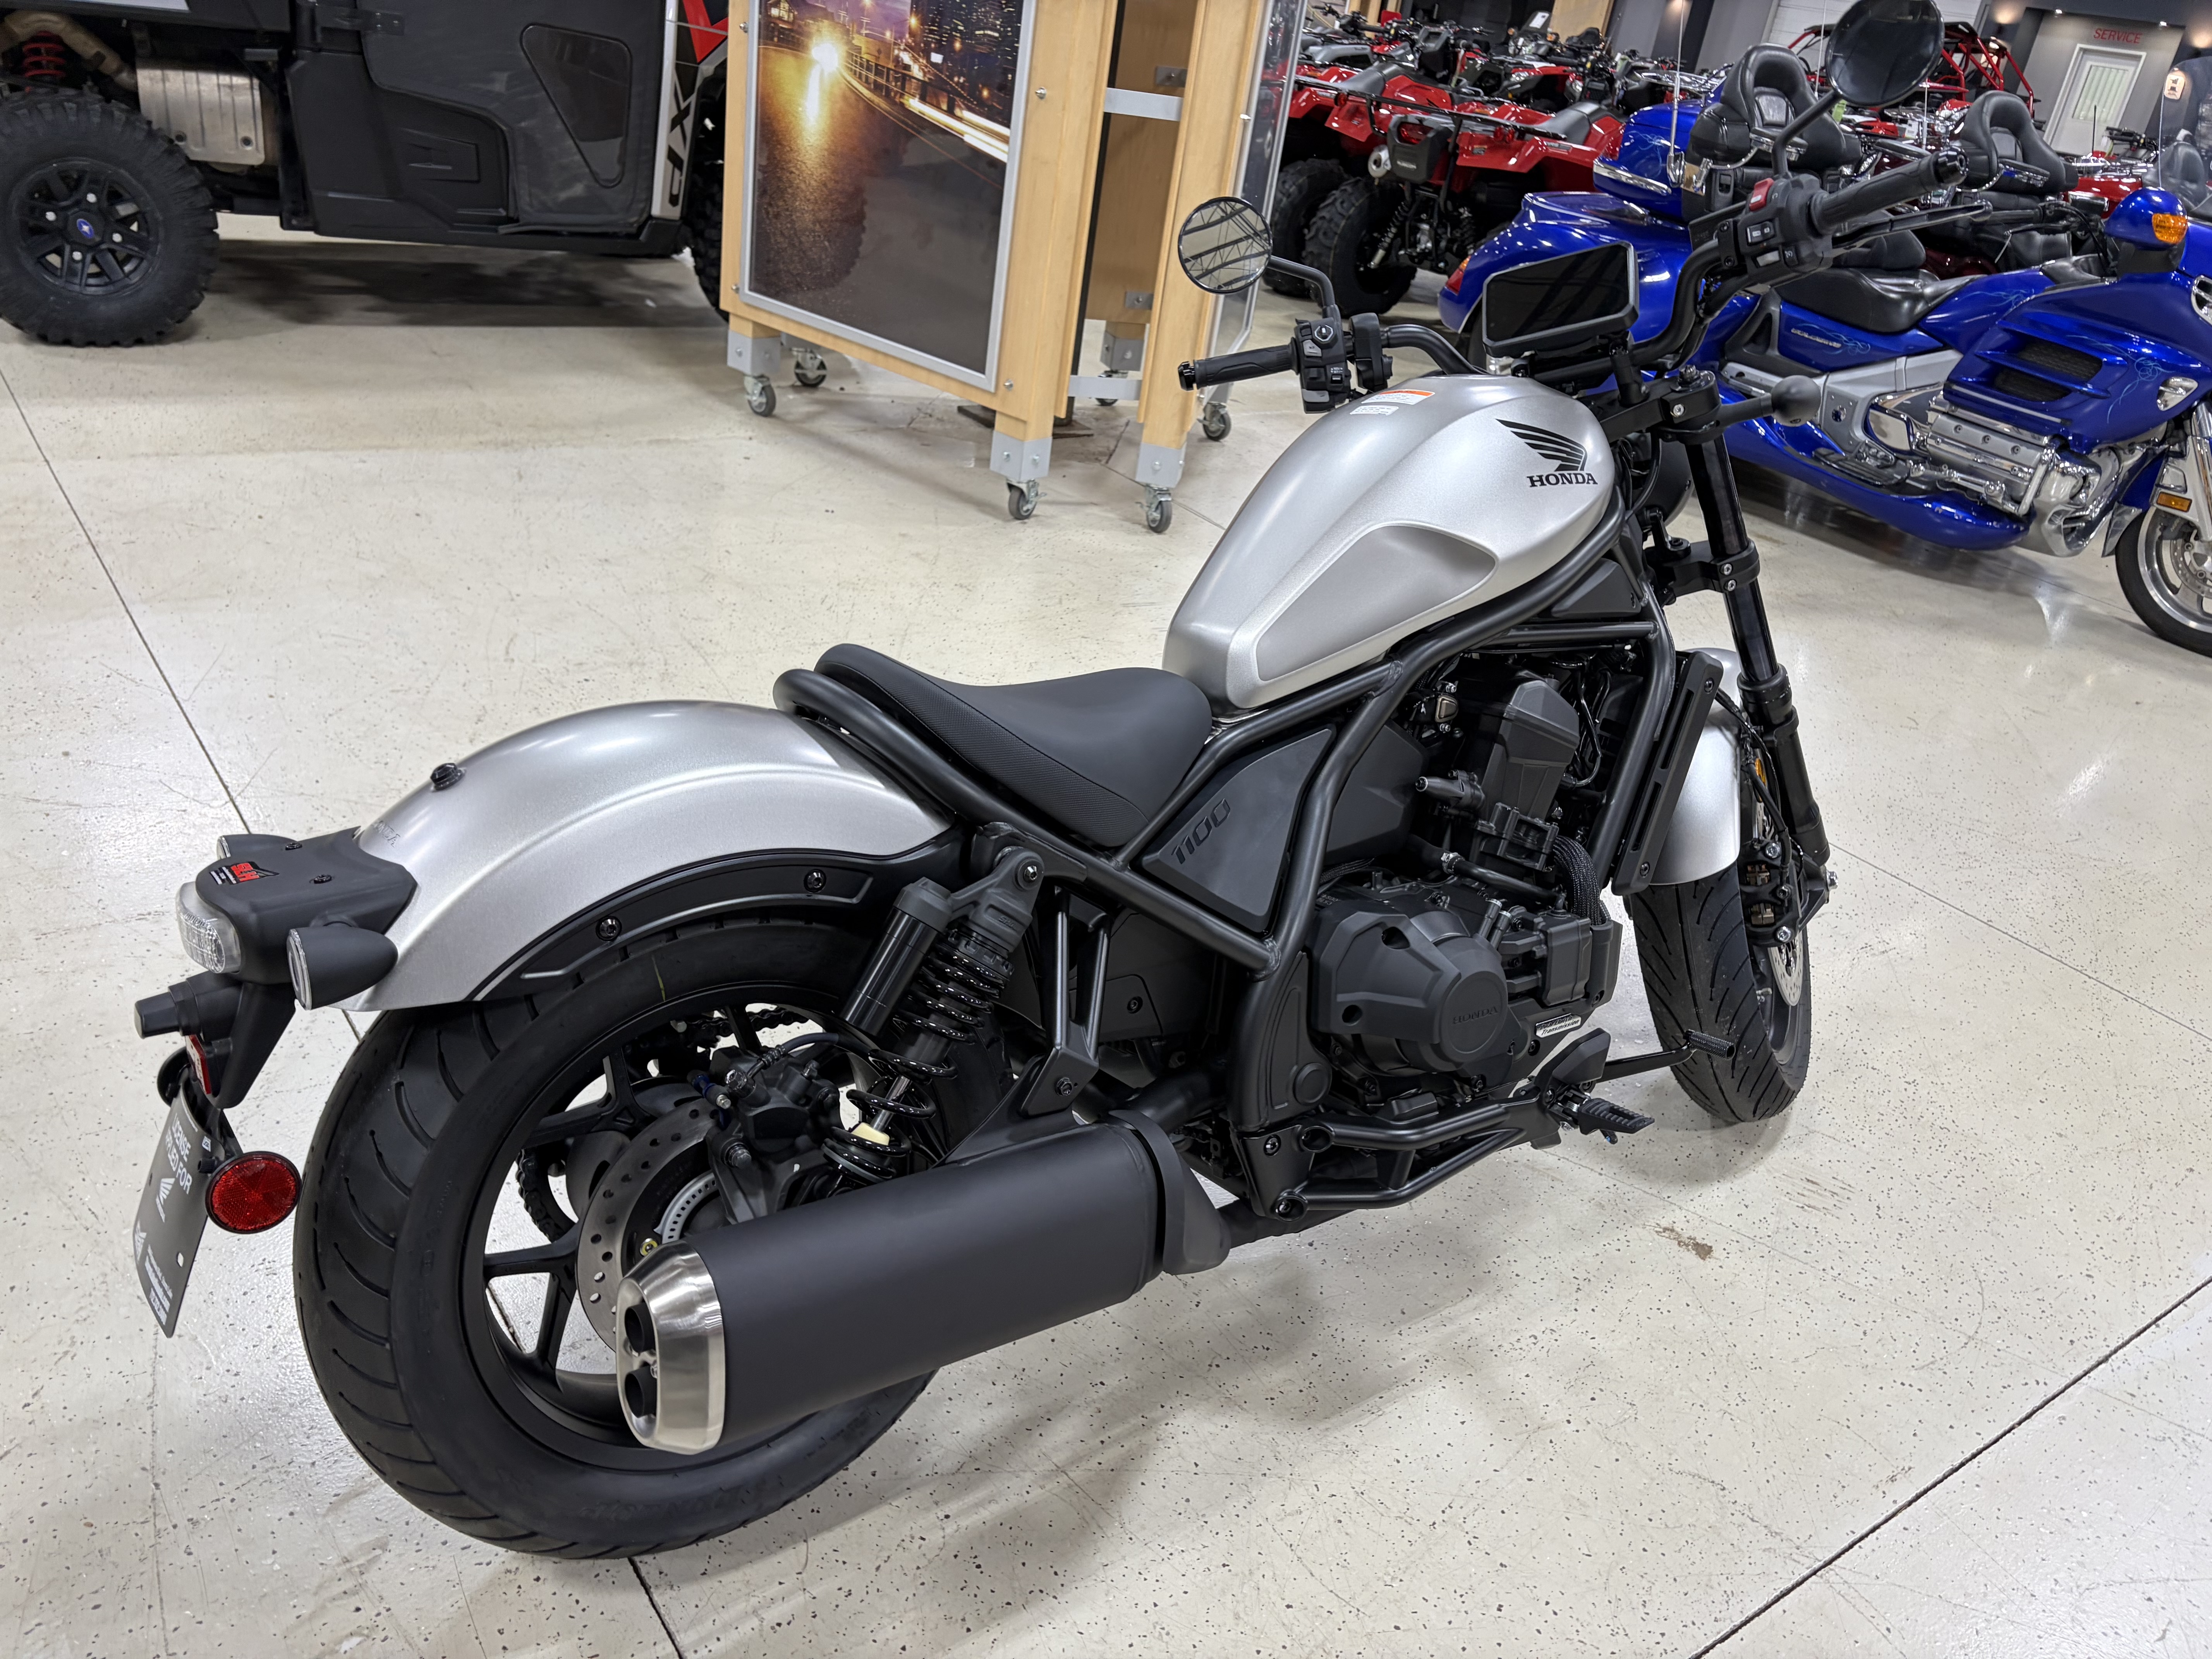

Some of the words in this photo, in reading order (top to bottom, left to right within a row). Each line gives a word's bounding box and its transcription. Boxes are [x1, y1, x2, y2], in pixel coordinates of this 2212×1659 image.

[2094, 28, 2143, 44] SERVICE
[667, 81, 692, 207] XP
[1527, 473, 1598, 488] HONDA
[1171, 798, 1231, 864] 1100
[1453, 1006, 1499, 1024] HONDA
[1541, 1019, 1580, 1036] Transmission
[172, 1113, 191, 1162] LICENSE
[176, 1161, 192, 1194] FOR
